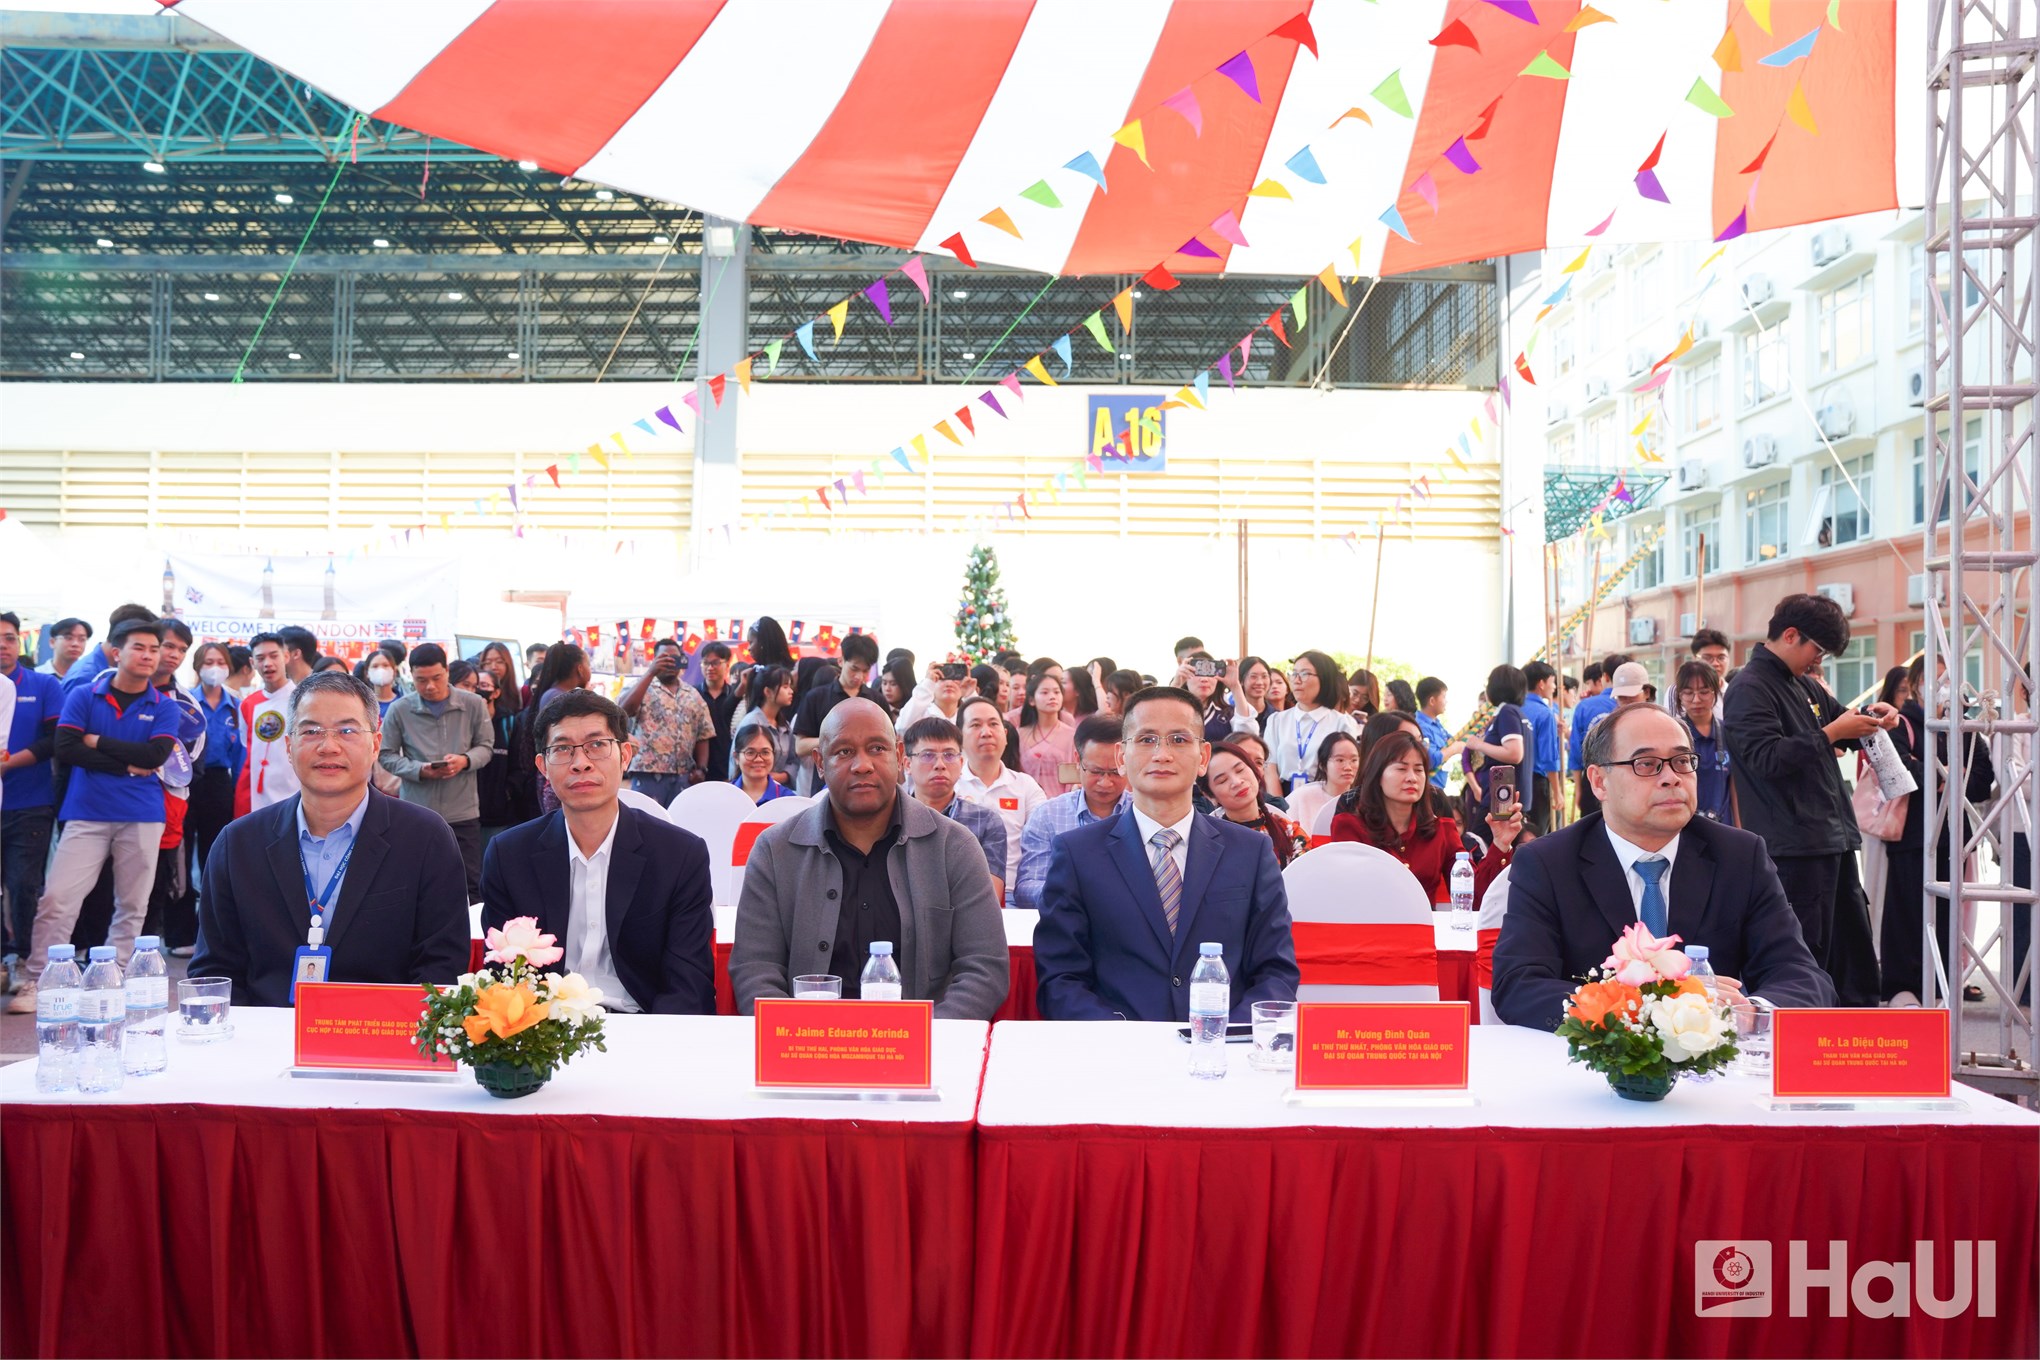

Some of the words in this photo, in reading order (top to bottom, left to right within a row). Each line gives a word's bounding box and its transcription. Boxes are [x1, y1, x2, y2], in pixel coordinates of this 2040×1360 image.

[1093, 406, 1162, 458] A.16
[187, 620, 263, 634] WELCOME
[303, 623, 371, 637] ONDON
[176, 751, 189, 773] HaUI
[53, 1003, 72, 1011] true
[315, 1018, 333, 1026] TRUNG
[776, 1027, 792, 1037] Mr.
[795, 1027, 825, 1037] Jaime
[828, 1027, 868, 1038] Eduardo
[871, 1028, 909, 1038] Xerinda
[1337, 1030, 1352, 1039] Mr.
[1355, 1030, 1382, 1041] Vương
[1385, 1029, 1405, 1039] Đình
[1818, 1037, 1834, 1047] Mr.
[1838, 1037, 1849, 1047] La
[1852, 1036, 1874, 1049] Diệu
[1877, 1037, 1909, 1049] Quang
[1366, 1052, 1387, 1060] TRUNG
